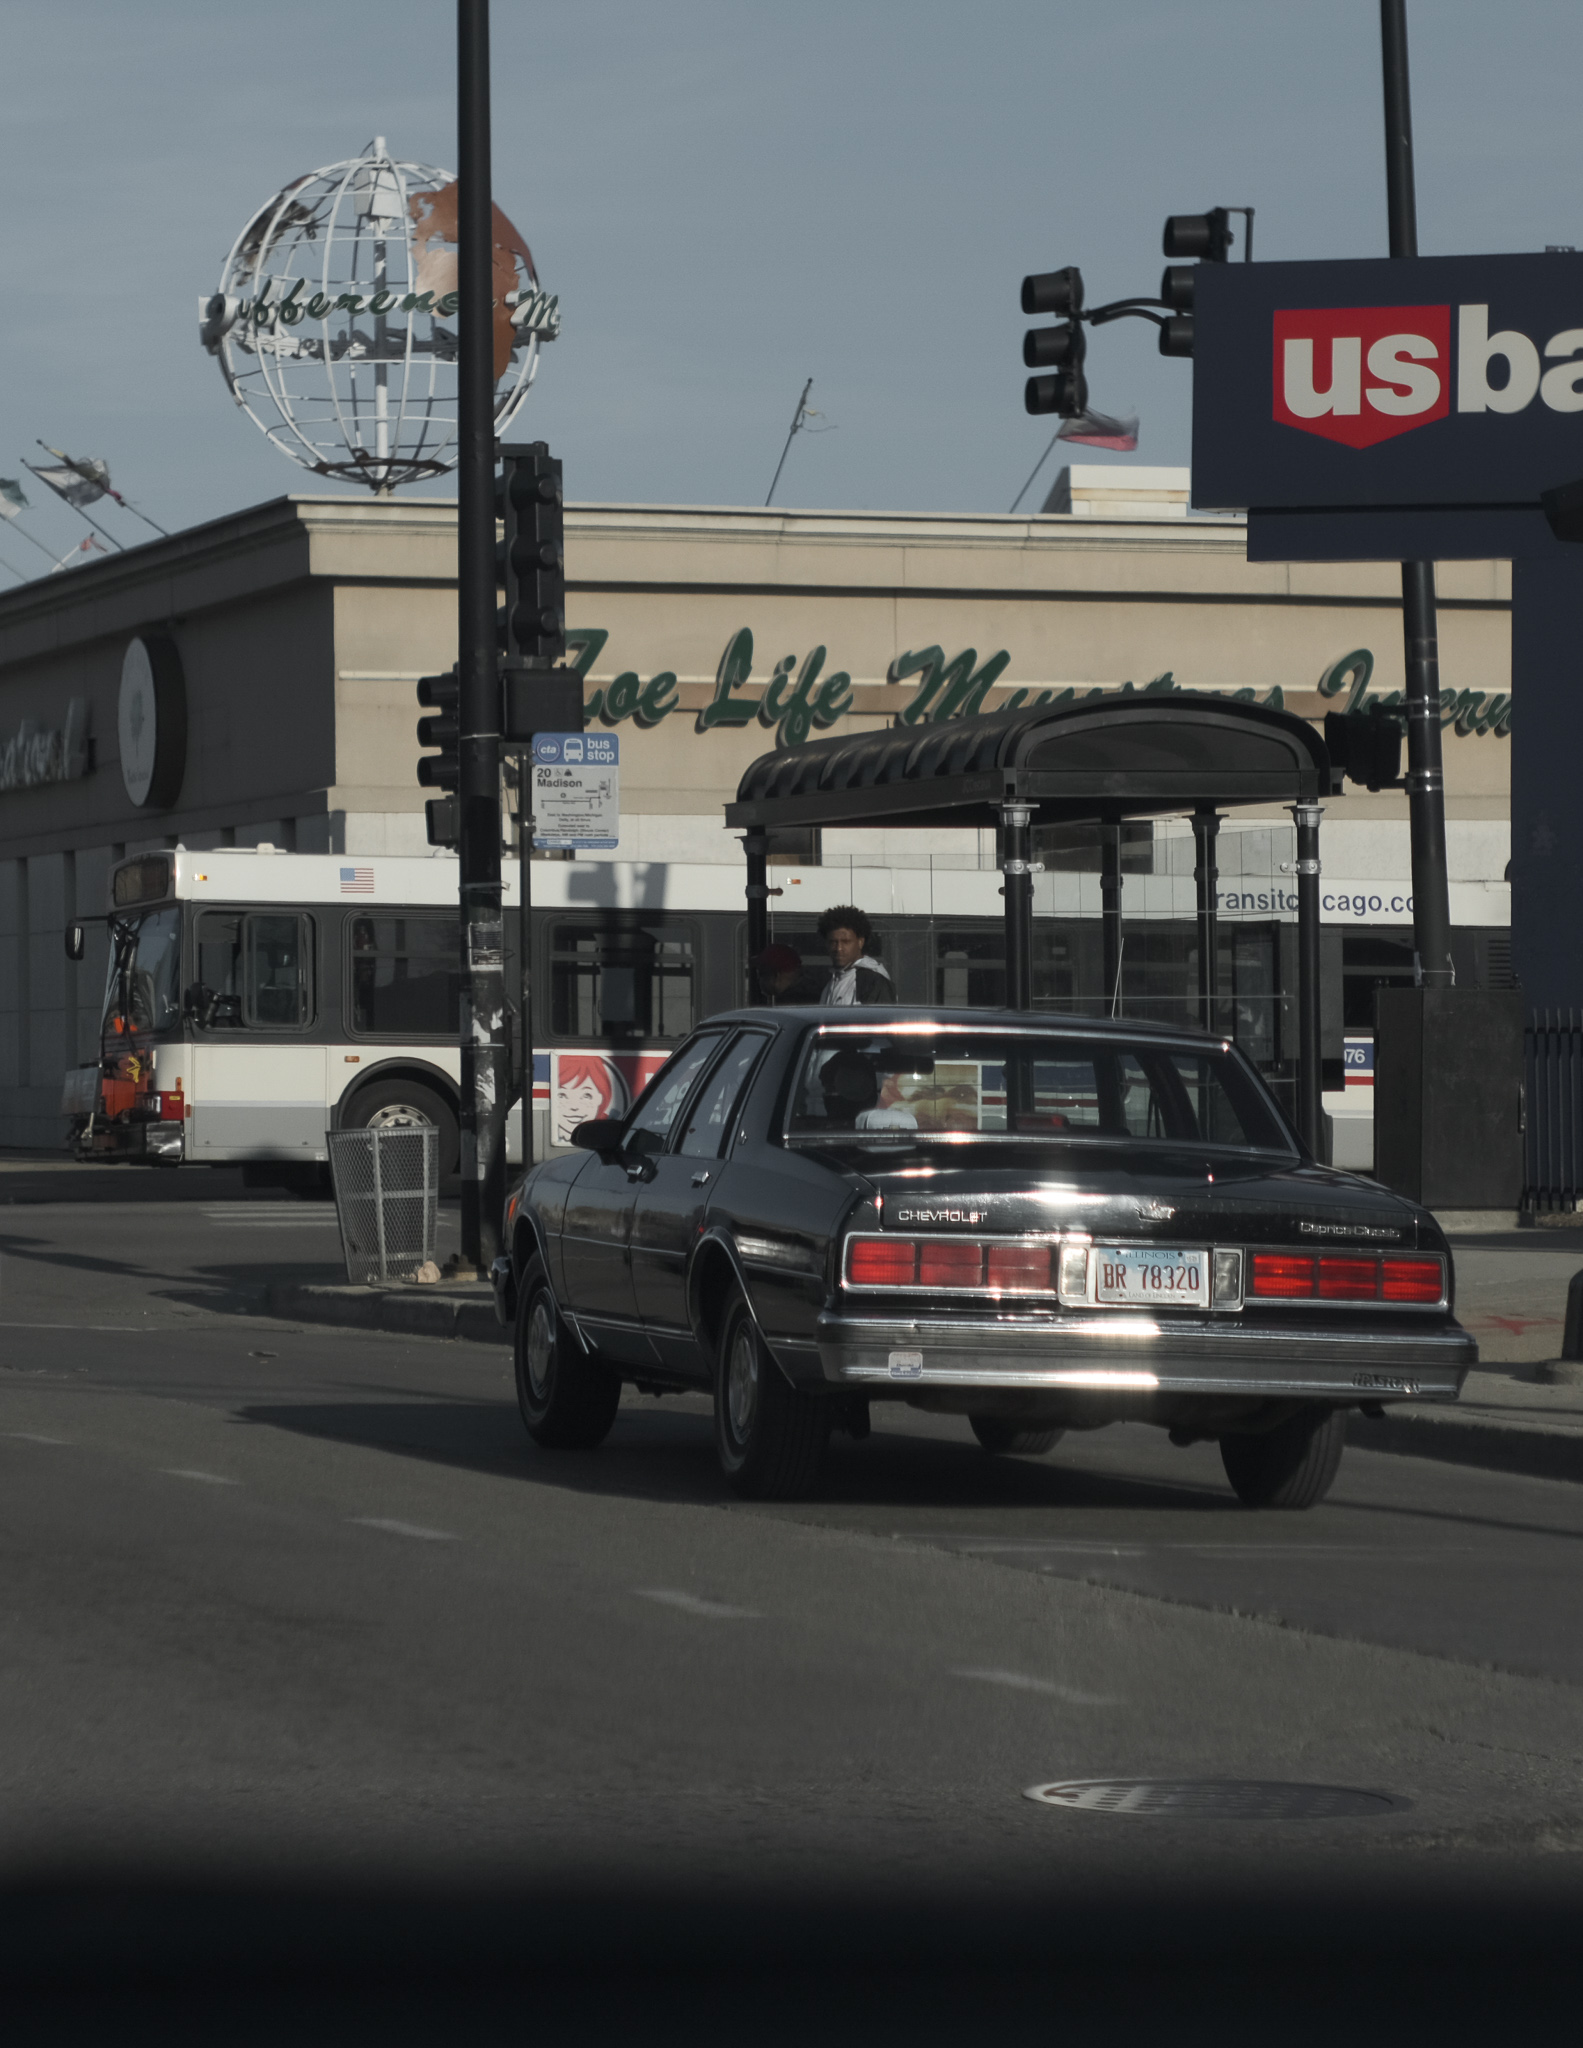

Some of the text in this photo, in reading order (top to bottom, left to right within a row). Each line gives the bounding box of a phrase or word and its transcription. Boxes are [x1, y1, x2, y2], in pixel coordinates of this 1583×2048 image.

[700, 627, 854, 746] Life
[540, 745, 557, 754] cta
[587, 738, 610, 749] bus
[587, 749, 615, 763] stop
[537, 768, 552, 778] 20
[537, 778, 583, 788] Madison
[1344, 1048, 1366, 1064] 76
[898, 1209, 988, 1223] CHEVROLET
[1300, 1222, 1352, 1236] Caprice
[1125, 1251, 1176, 1260] ILLINOIS
[1102, 1263, 1200, 1291] BR 78320
